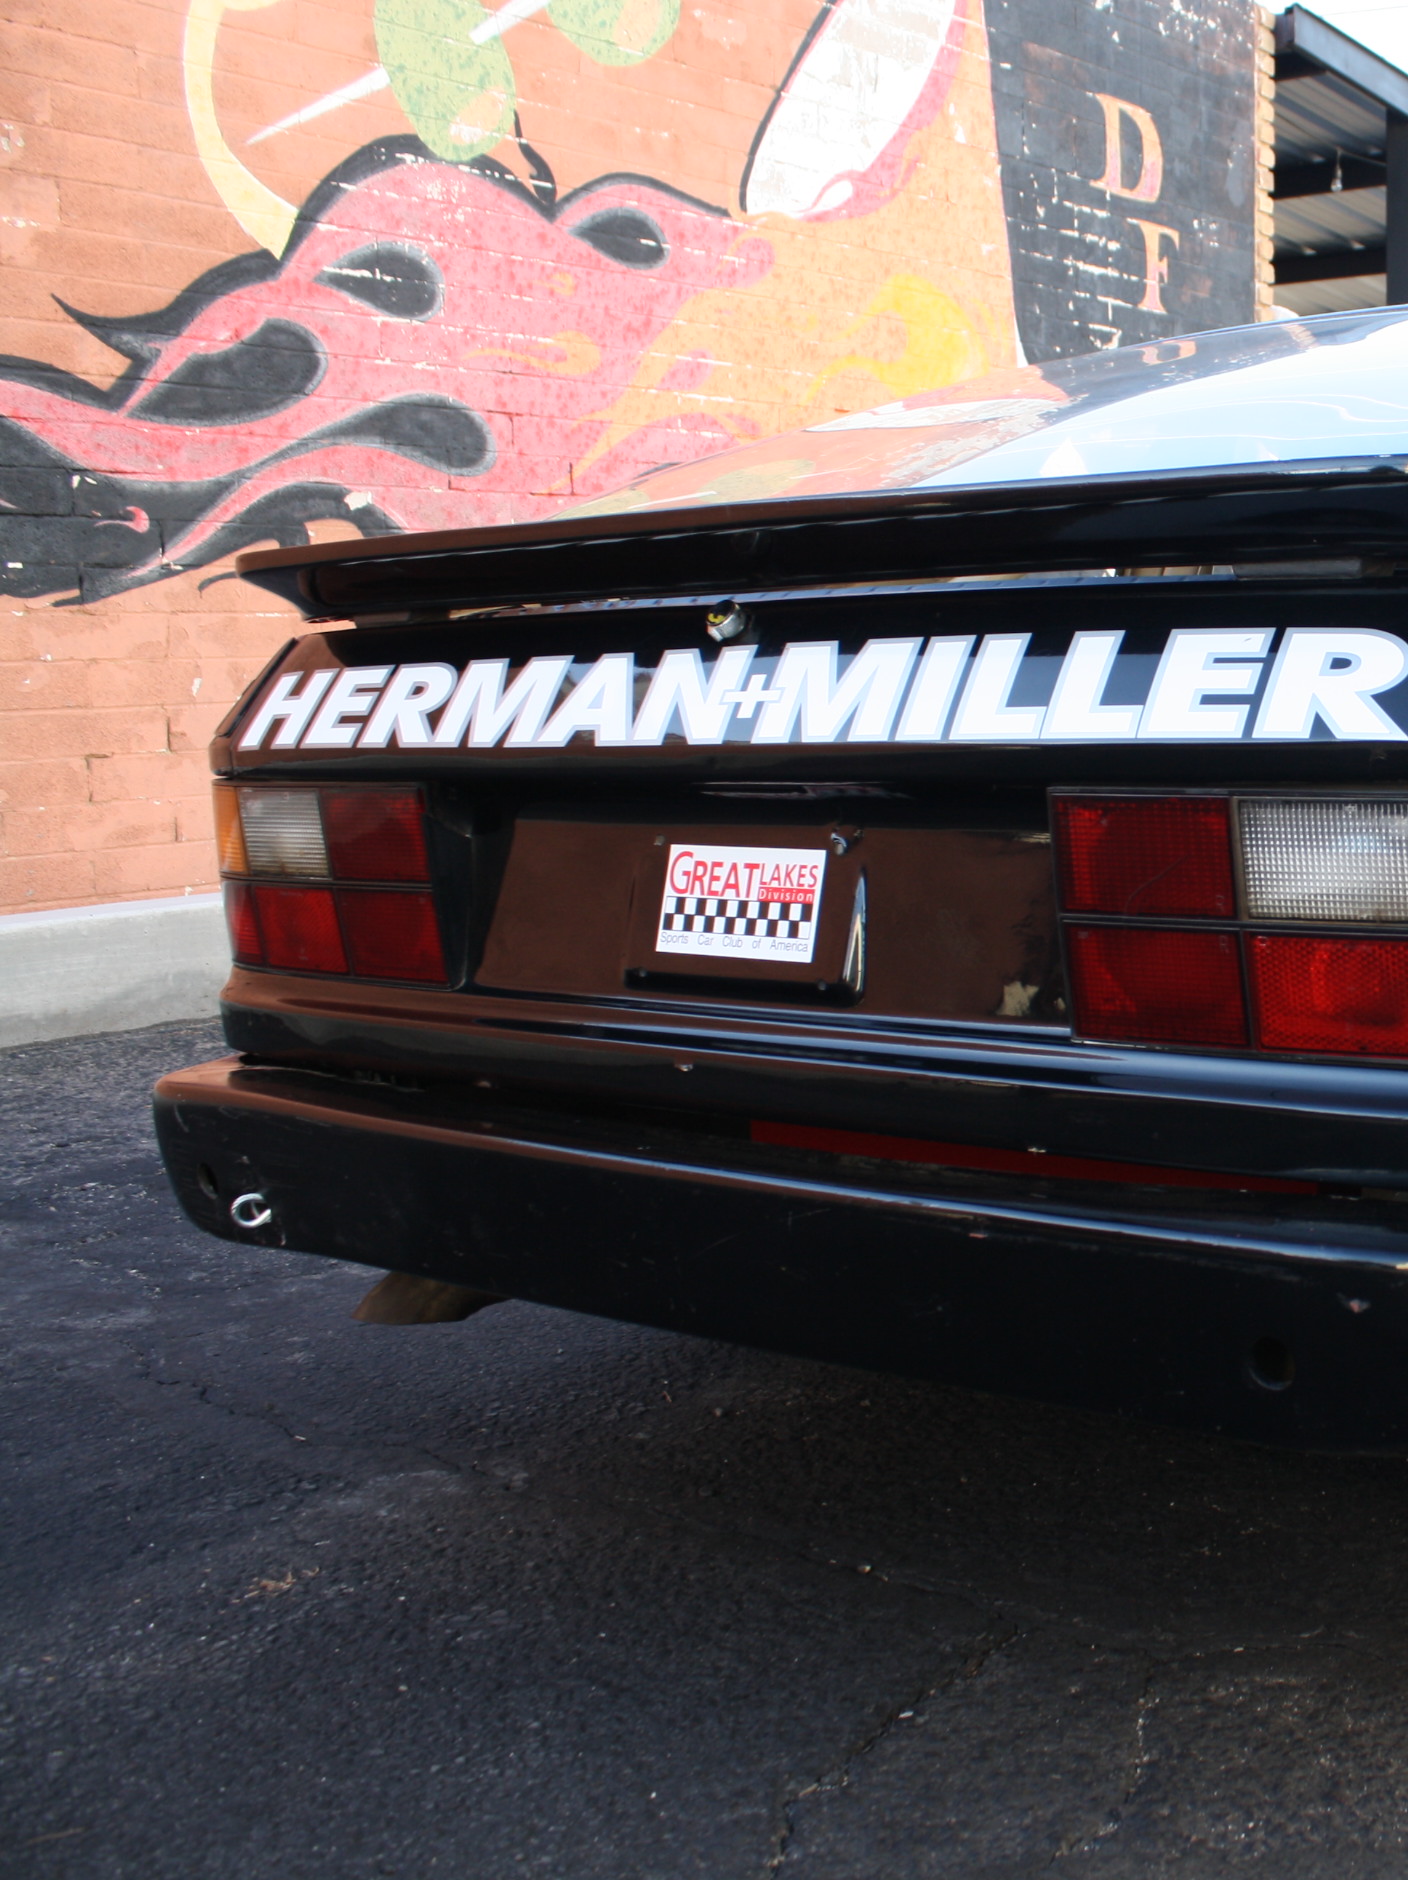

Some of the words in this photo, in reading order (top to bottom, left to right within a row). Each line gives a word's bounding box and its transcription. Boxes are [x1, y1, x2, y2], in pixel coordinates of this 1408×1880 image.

[1089, 92, 1164, 204] D
[1130, 218, 1180, 315] F
[669, 850, 760, 899] GREAT
[759, 863, 819, 889] LAKES
[758, 888, 815, 903] Division
[659, 931, 689, 945] Sports
[697, 933, 714, 946] Car
[722, 936, 744, 949] Club
[752, 938, 761, 949] of
[770, 939, 809, 953] America
